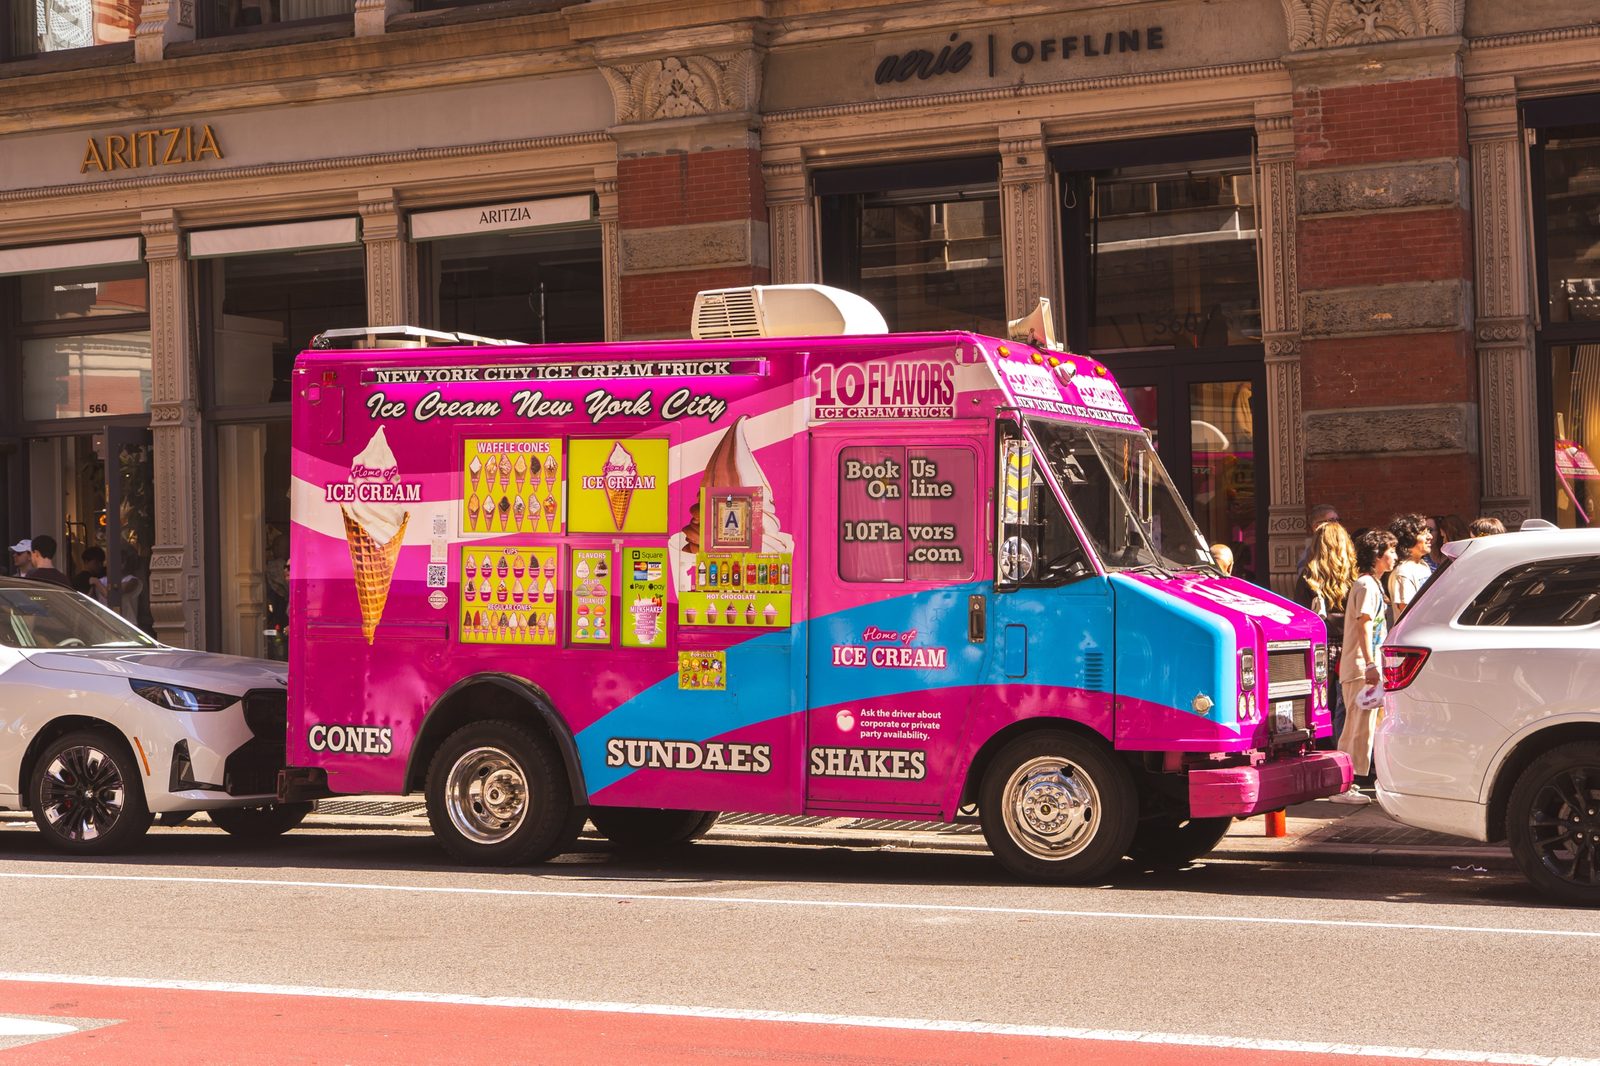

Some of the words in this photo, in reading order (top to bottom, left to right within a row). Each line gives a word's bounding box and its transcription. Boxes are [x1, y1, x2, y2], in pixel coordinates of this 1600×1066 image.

[874, 32, 974, 85] aerie
[1011, 26, 1164, 64] OFFLINE
[80, 124, 224, 174] ARITZIA
[479, 207, 531, 224] ARITZIA
[377, 370, 420, 383] NEW
[421, 369, 480, 382] YORK
[484, 367, 532, 381] CITY
[536, 365, 572, 379] ICE
[577, 363, 656, 378] CREAM
[658, 361, 730, 376] TRUCK
[813, 365, 865, 405] 10
[868, 362, 955, 405] FLAVORS
[89, 404, 108, 413] 560
[366, 392, 406, 419] Ice
[415, 391, 501, 421] Cream
[512, 390, 573, 419] New
[584, 388, 652, 423] York
[661, 389, 726, 422] City
[819, 407, 843, 418] ICE
[846, 407, 896, 418] CREAM
[901, 407, 950, 418] TRUCK
[477, 442, 515, 453] WAFFLE
[517, 442, 550, 453] CONES
[352, 465, 380, 478] Home
[383, 466, 397, 481] of
[846, 461, 899, 479] Book
[911, 460, 936, 477] Us
[583, 476, 604, 489] ICE
[607, 476, 656, 489] CREAM
[867, 480, 900, 498] On
[911, 479, 953, 497] line
[326, 484, 355, 501] ICE
[359, 484, 421, 501] CREAM
[725, 511, 738, 528] A
[844, 523, 902, 540] 10Fla
[908, 525, 954, 540] vors
[908, 547, 961, 562] .com
[863, 628, 896, 641] Home
[901, 629, 916, 644] of
[833, 647, 866, 665] ICE
[872, 647, 946, 667] CREAM
[860, 709, 875, 717] Ask
[877, 709, 890, 717] the
[891, 709, 916, 718] driver
[917, 710, 942, 719] about
[860, 720, 899, 730] corporate
[911, 720, 940, 730] private
[308, 725, 392, 755] CONES
[860, 731, 882, 739] party
[883, 730, 930, 741] availability.
[607, 739, 772, 774] SUNDAES
[810, 748, 926, 780] SHAKES
